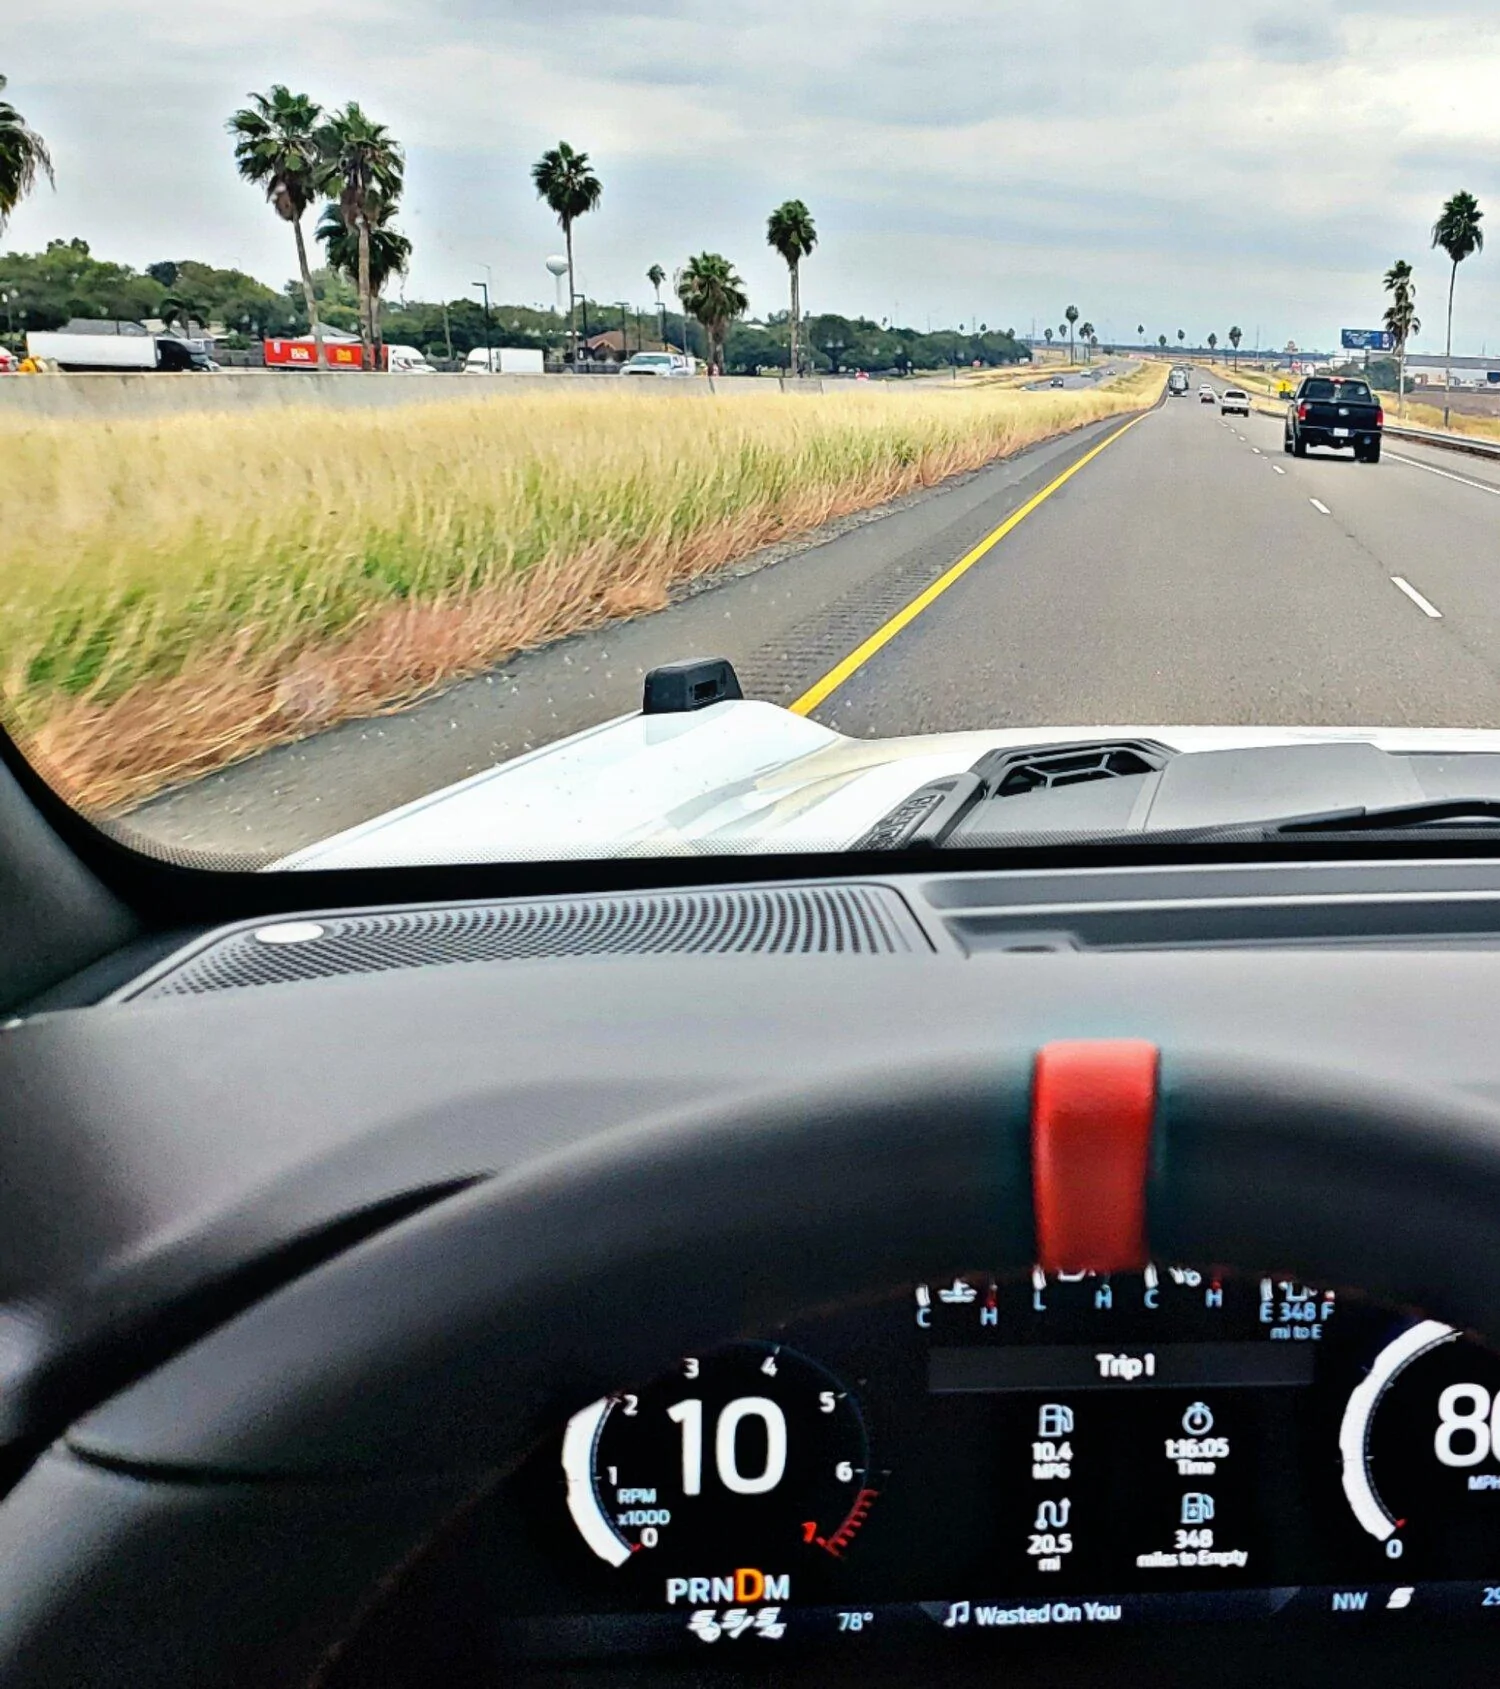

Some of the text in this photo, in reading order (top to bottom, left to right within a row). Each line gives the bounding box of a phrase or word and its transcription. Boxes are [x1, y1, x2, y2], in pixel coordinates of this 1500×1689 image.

[1033, 1291, 1047, 1311] L
[1095, 1290, 1112, 1309] H
[1144, 1289, 1159, 1309] C
[1206, 1289, 1223, 1308] H
[916, 1308, 931, 1328] C
[980, 1307, 998, 1326] H
[1259, 1302, 1336, 1322] E 348 F
[1270, 1324, 1321, 1340] mi to E
[683, 1357, 700, 1378] 3
[760, 1357, 778, 1377] 4
[1095, 1353, 1155, 1381] Trip 1
[622, 1394, 638, 1416] 2
[818, 1391, 836, 1413] 5
[667, 1396, 787, 1496] 10
[1031, 1441, 1074, 1462] 10.4
[607, 1466, 618, 1486] 1
[835, 1462, 853, 1482] 6
[1176, 1459, 1217, 1476] Time
[617, 1488, 657, 1504] RPM
[617, 1509, 671, 1526] x1000
[640, 1527, 659, 1548] 0
[802, 1522, 818, 1543] 7
[1174, 1528, 1214, 1549] 348
[1026, 1533, 1073, 1554] 20.5
[1385, 1538, 1404, 1559] 0
[1038, 1555, 1061, 1572] mi
[1136, 1549, 1249, 1568] miles to Empty
[1332, 1591, 1368, 1611] NW
[838, 1611, 874, 1631] 78°
[974, 1601, 1122, 1626] Wasted On You
